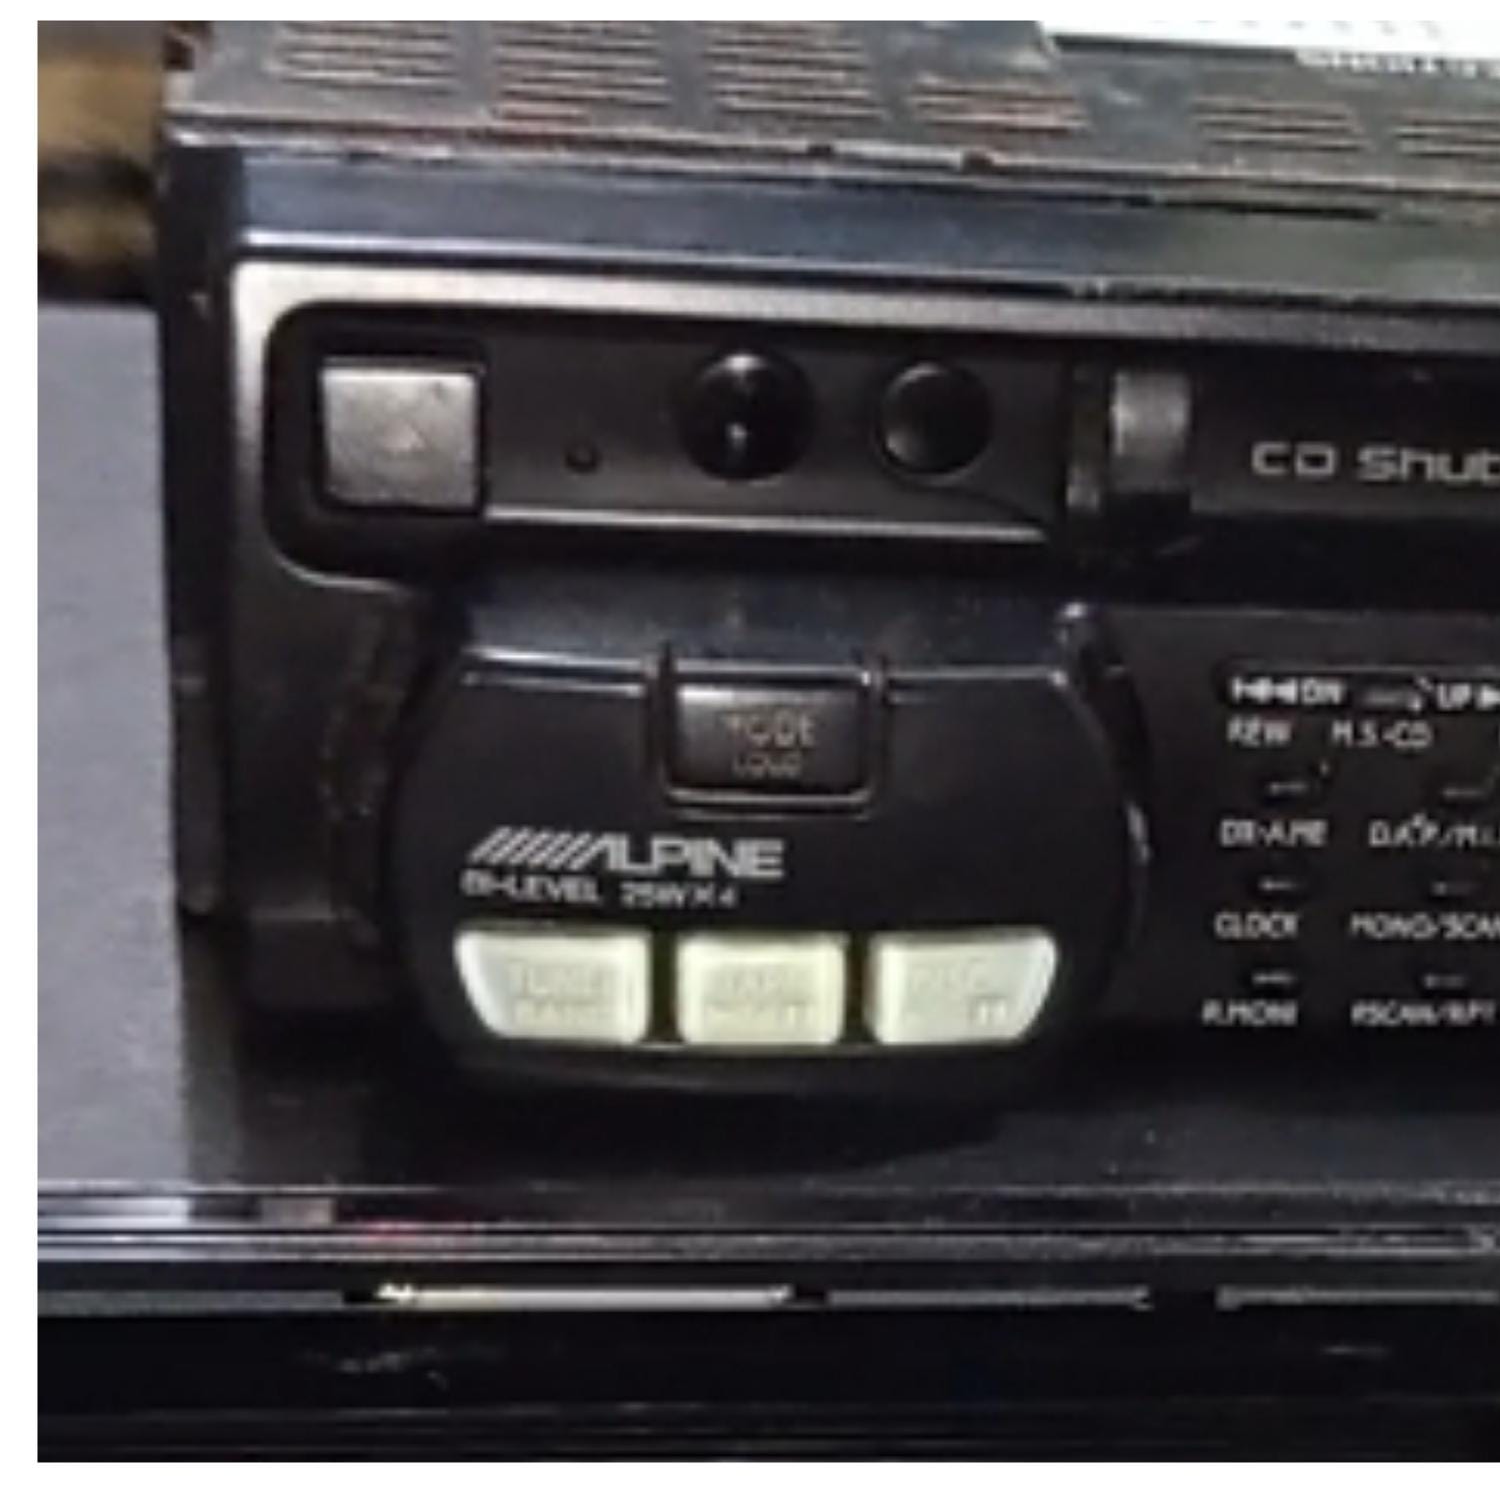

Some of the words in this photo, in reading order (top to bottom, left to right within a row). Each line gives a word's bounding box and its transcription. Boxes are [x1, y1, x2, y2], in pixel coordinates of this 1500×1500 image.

[1251, 441, 1337, 477] CD
[1227, 716, 1292, 748] REW
[568, 832, 784, 879] ALPINE
[1214, 912, 1299, 940] CLOCK
